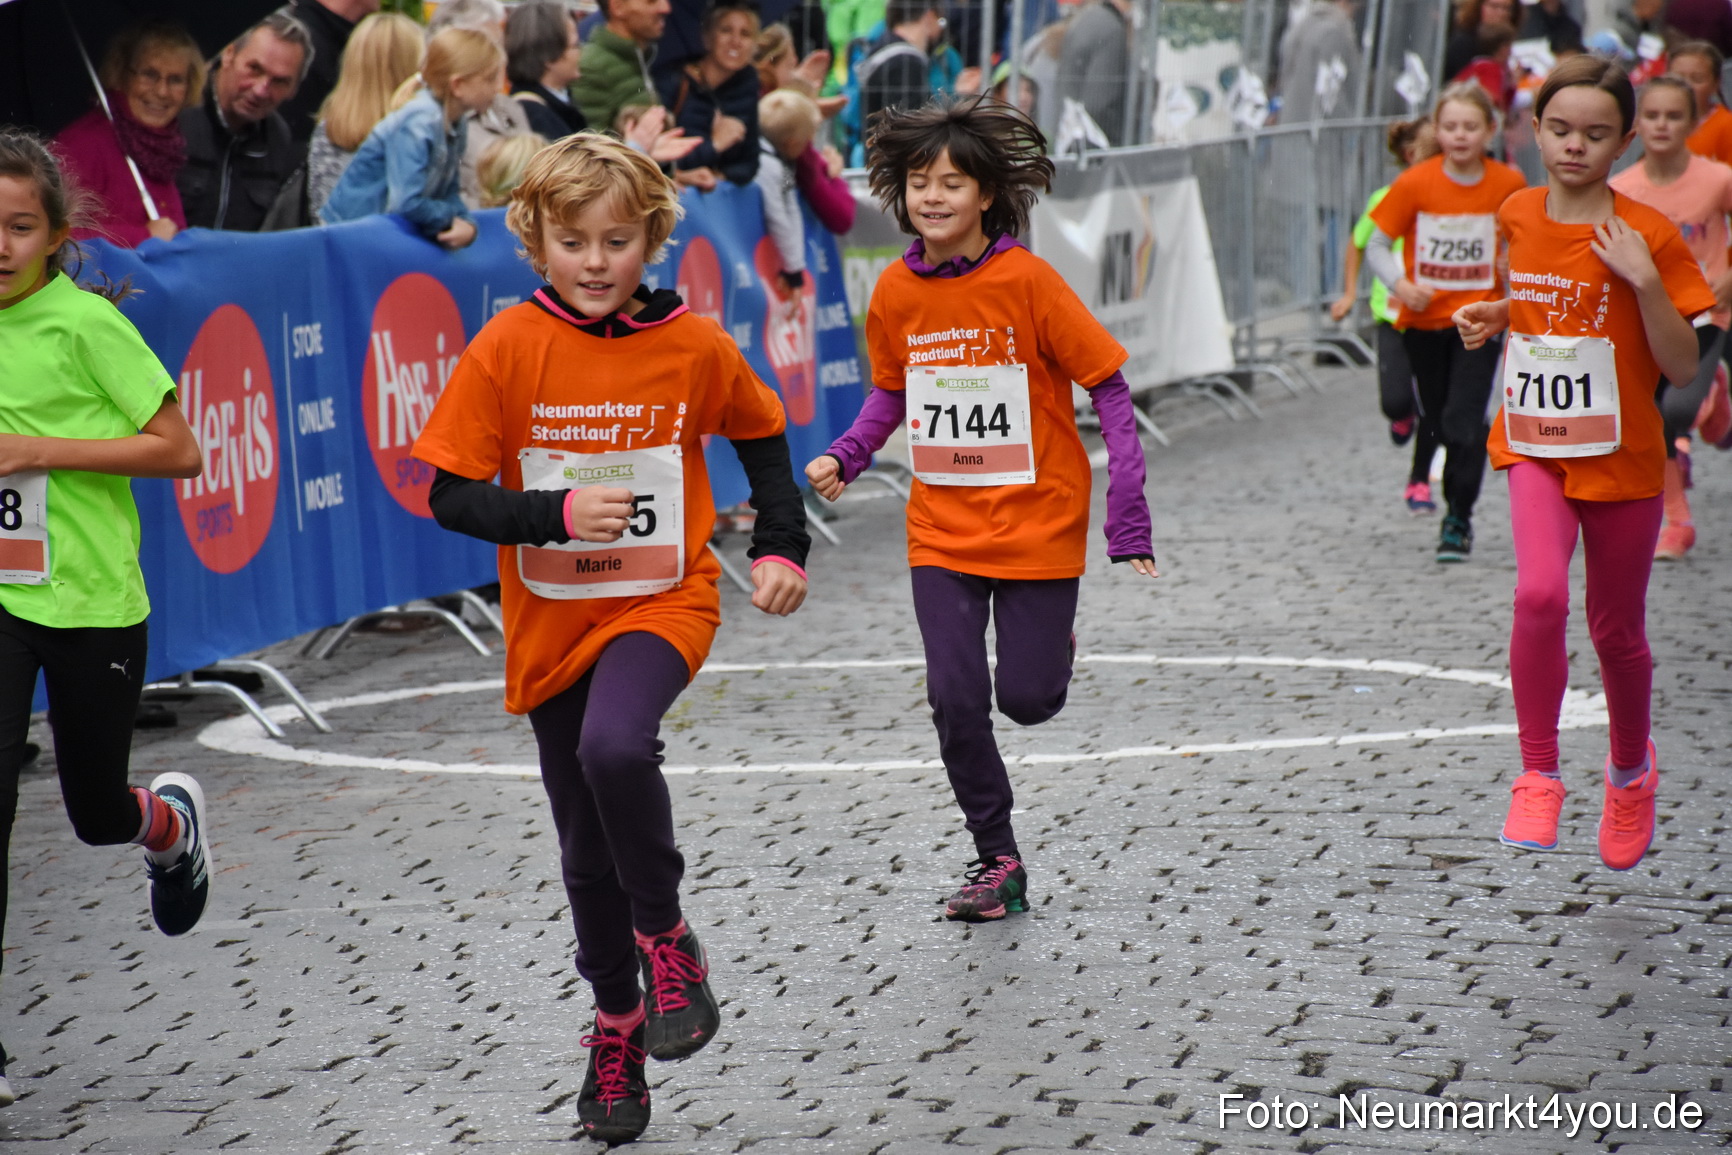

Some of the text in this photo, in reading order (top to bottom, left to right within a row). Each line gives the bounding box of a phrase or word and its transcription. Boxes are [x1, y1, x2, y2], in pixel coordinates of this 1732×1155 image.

[1429, 237, 1483, 261] 7256
[907, 328, 980, 346] Neumarkter
[909, 344, 966, 365] Stadtlauf
[1537, 347, 1578, 358] BOCK
[948, 378, 990, 388] BOCK
[1517, 371, 1592, 410] 7101
[298, 396, 336, 435] ONLINE
[531, 401, 644, 418] Neumarkter
[924, 403, 1011, 439] 7144
[1539, 422, 1567, 437] Lena
[181, 367, 274, 516] Hervis
[531, 424, 621, 444] Stadtlauf
[953, 452, 984, 465] Anna
[578, 463, 634, 480] BOCK
[304, 472, 344, 512] MOBILE
[576, 556, 622, 574] Marie
